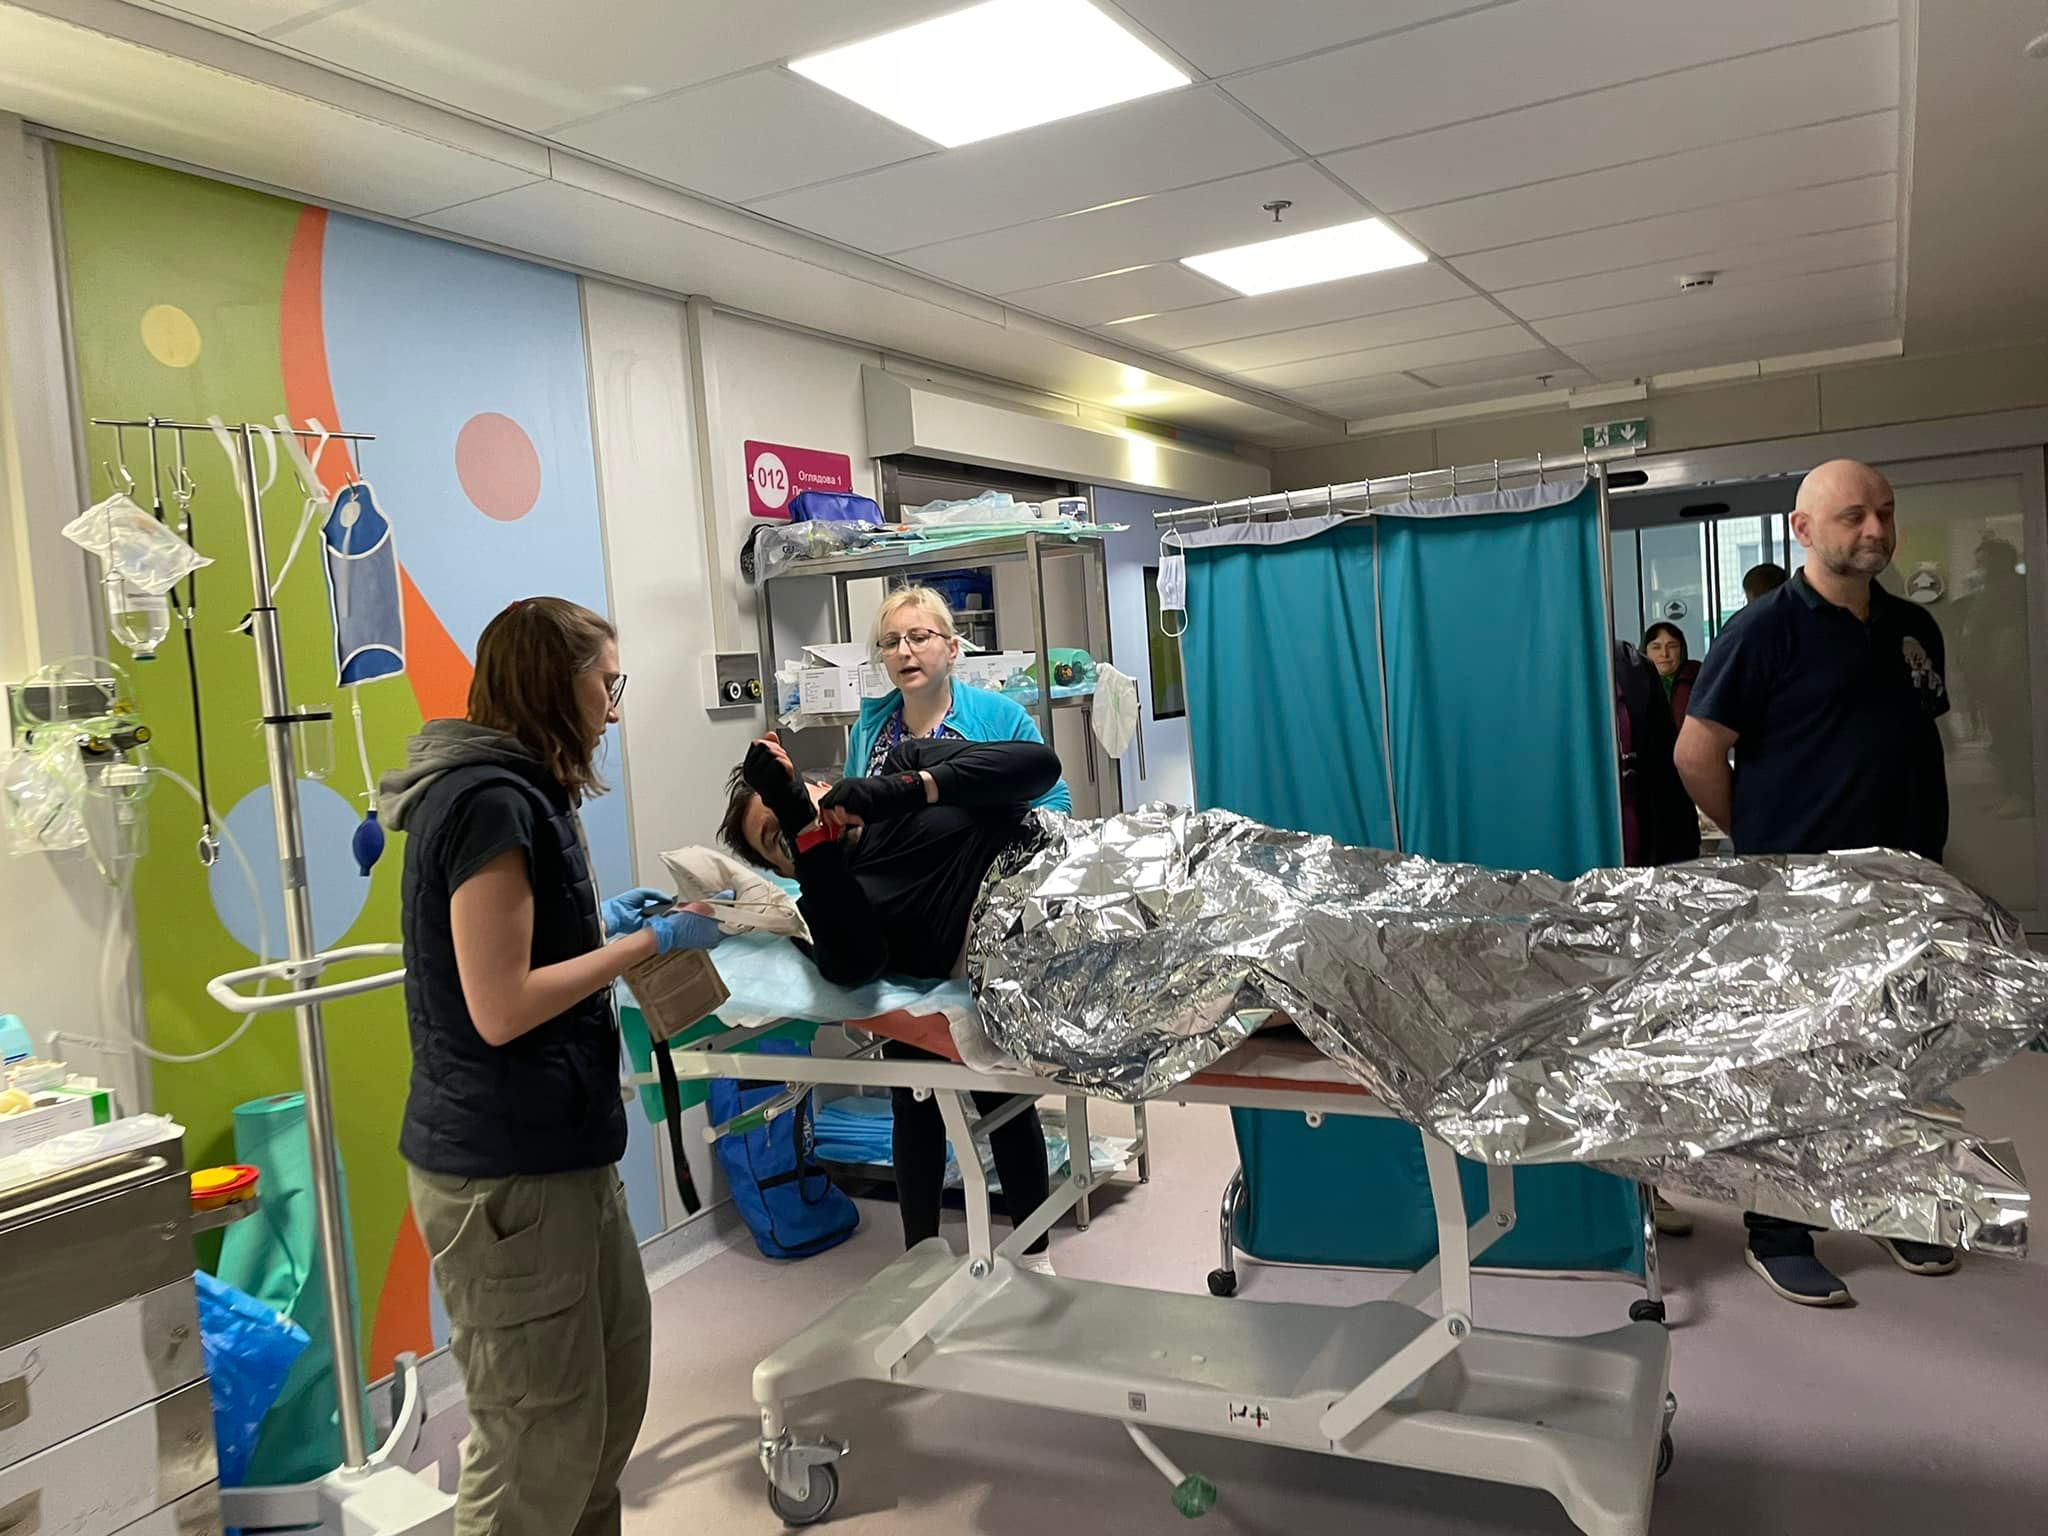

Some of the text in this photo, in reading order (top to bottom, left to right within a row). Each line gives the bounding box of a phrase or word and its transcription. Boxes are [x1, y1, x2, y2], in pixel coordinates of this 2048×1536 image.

[758, 467, 785, 490] 012
[798, 470, 842, 486] Оглядова 1
